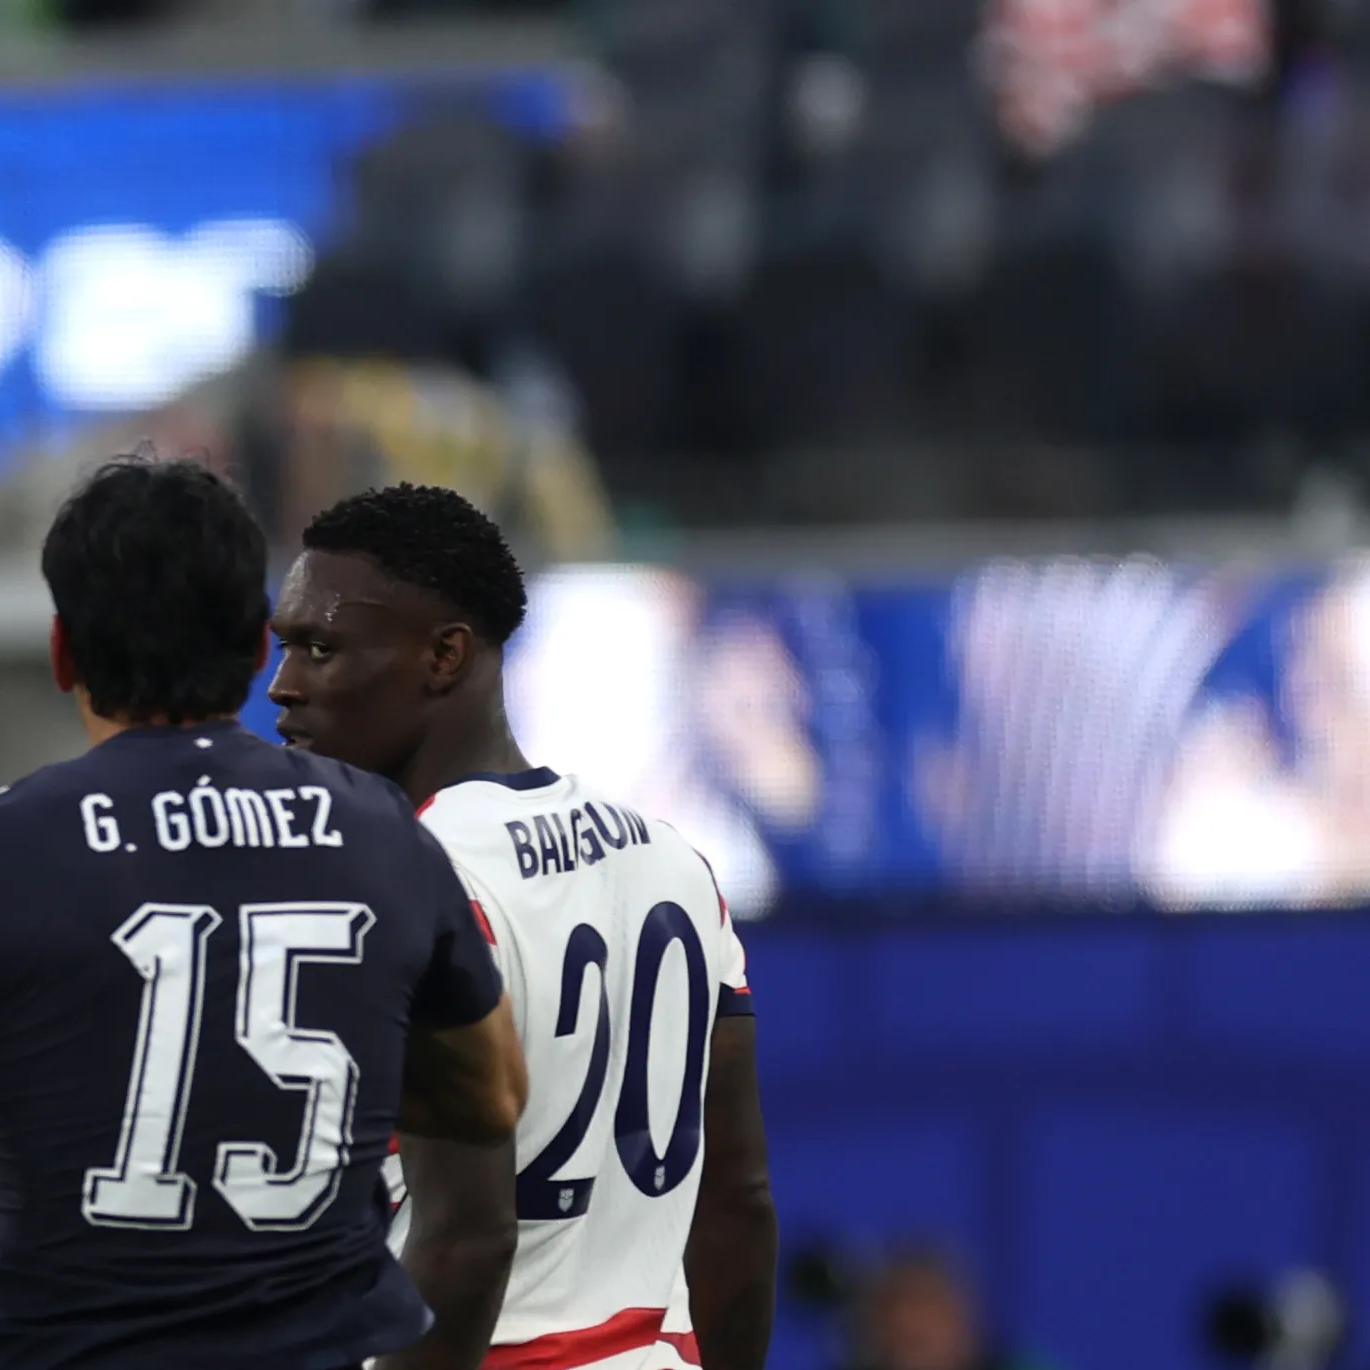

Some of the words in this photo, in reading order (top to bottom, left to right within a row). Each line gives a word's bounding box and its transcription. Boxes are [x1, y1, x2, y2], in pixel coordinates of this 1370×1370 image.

[81, 793, 137, 853] G.
[152, 774, 344, 851] GÓMEZ
[82, 901, 376, 1231] 15
[516, 901, 710, 1221] 20
